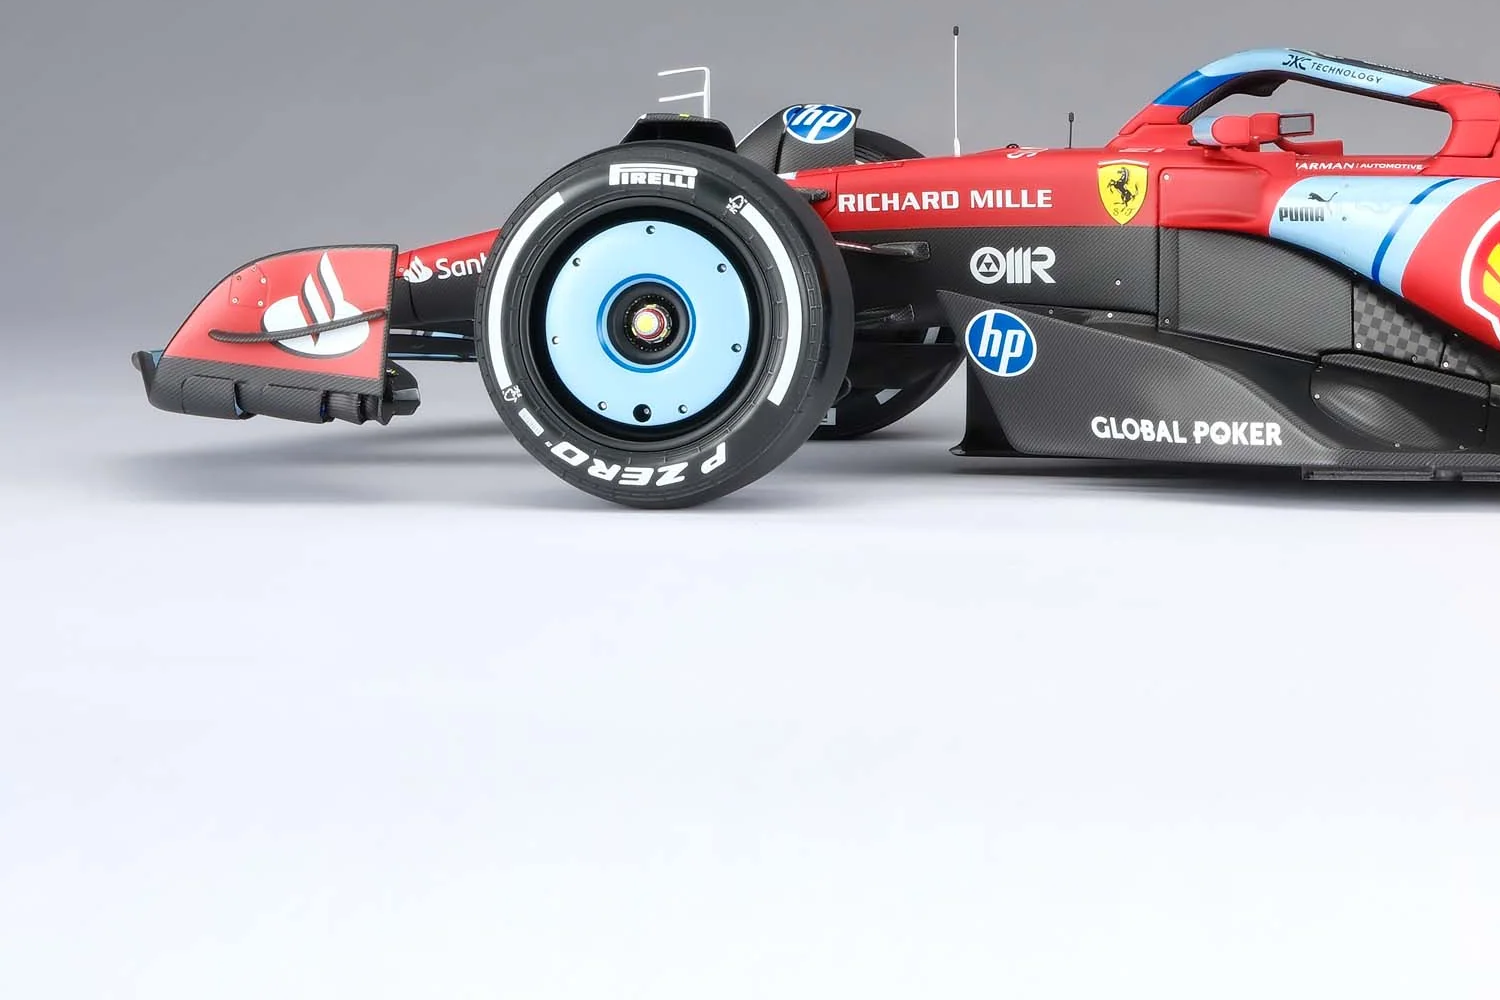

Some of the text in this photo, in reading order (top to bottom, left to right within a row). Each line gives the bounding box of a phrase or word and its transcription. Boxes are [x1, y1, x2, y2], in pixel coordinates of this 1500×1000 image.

[1311, 61, 1383, 84] TECHNOLOGY
[791, 104, 846, 143] hp
[608, 163, 699, 190] PIRELLI
[1360, 162, 1424, 171] AUTOMOTIVE
[838, 189, 1053, 213] RICHARD MILLE
[1279, 206, 1325, 222] PUMA
[977, 310, 1027, 375] hp
[1091, 416, 1283, 446] GLOBAL POKER
[701, 442, 727, 474] P
